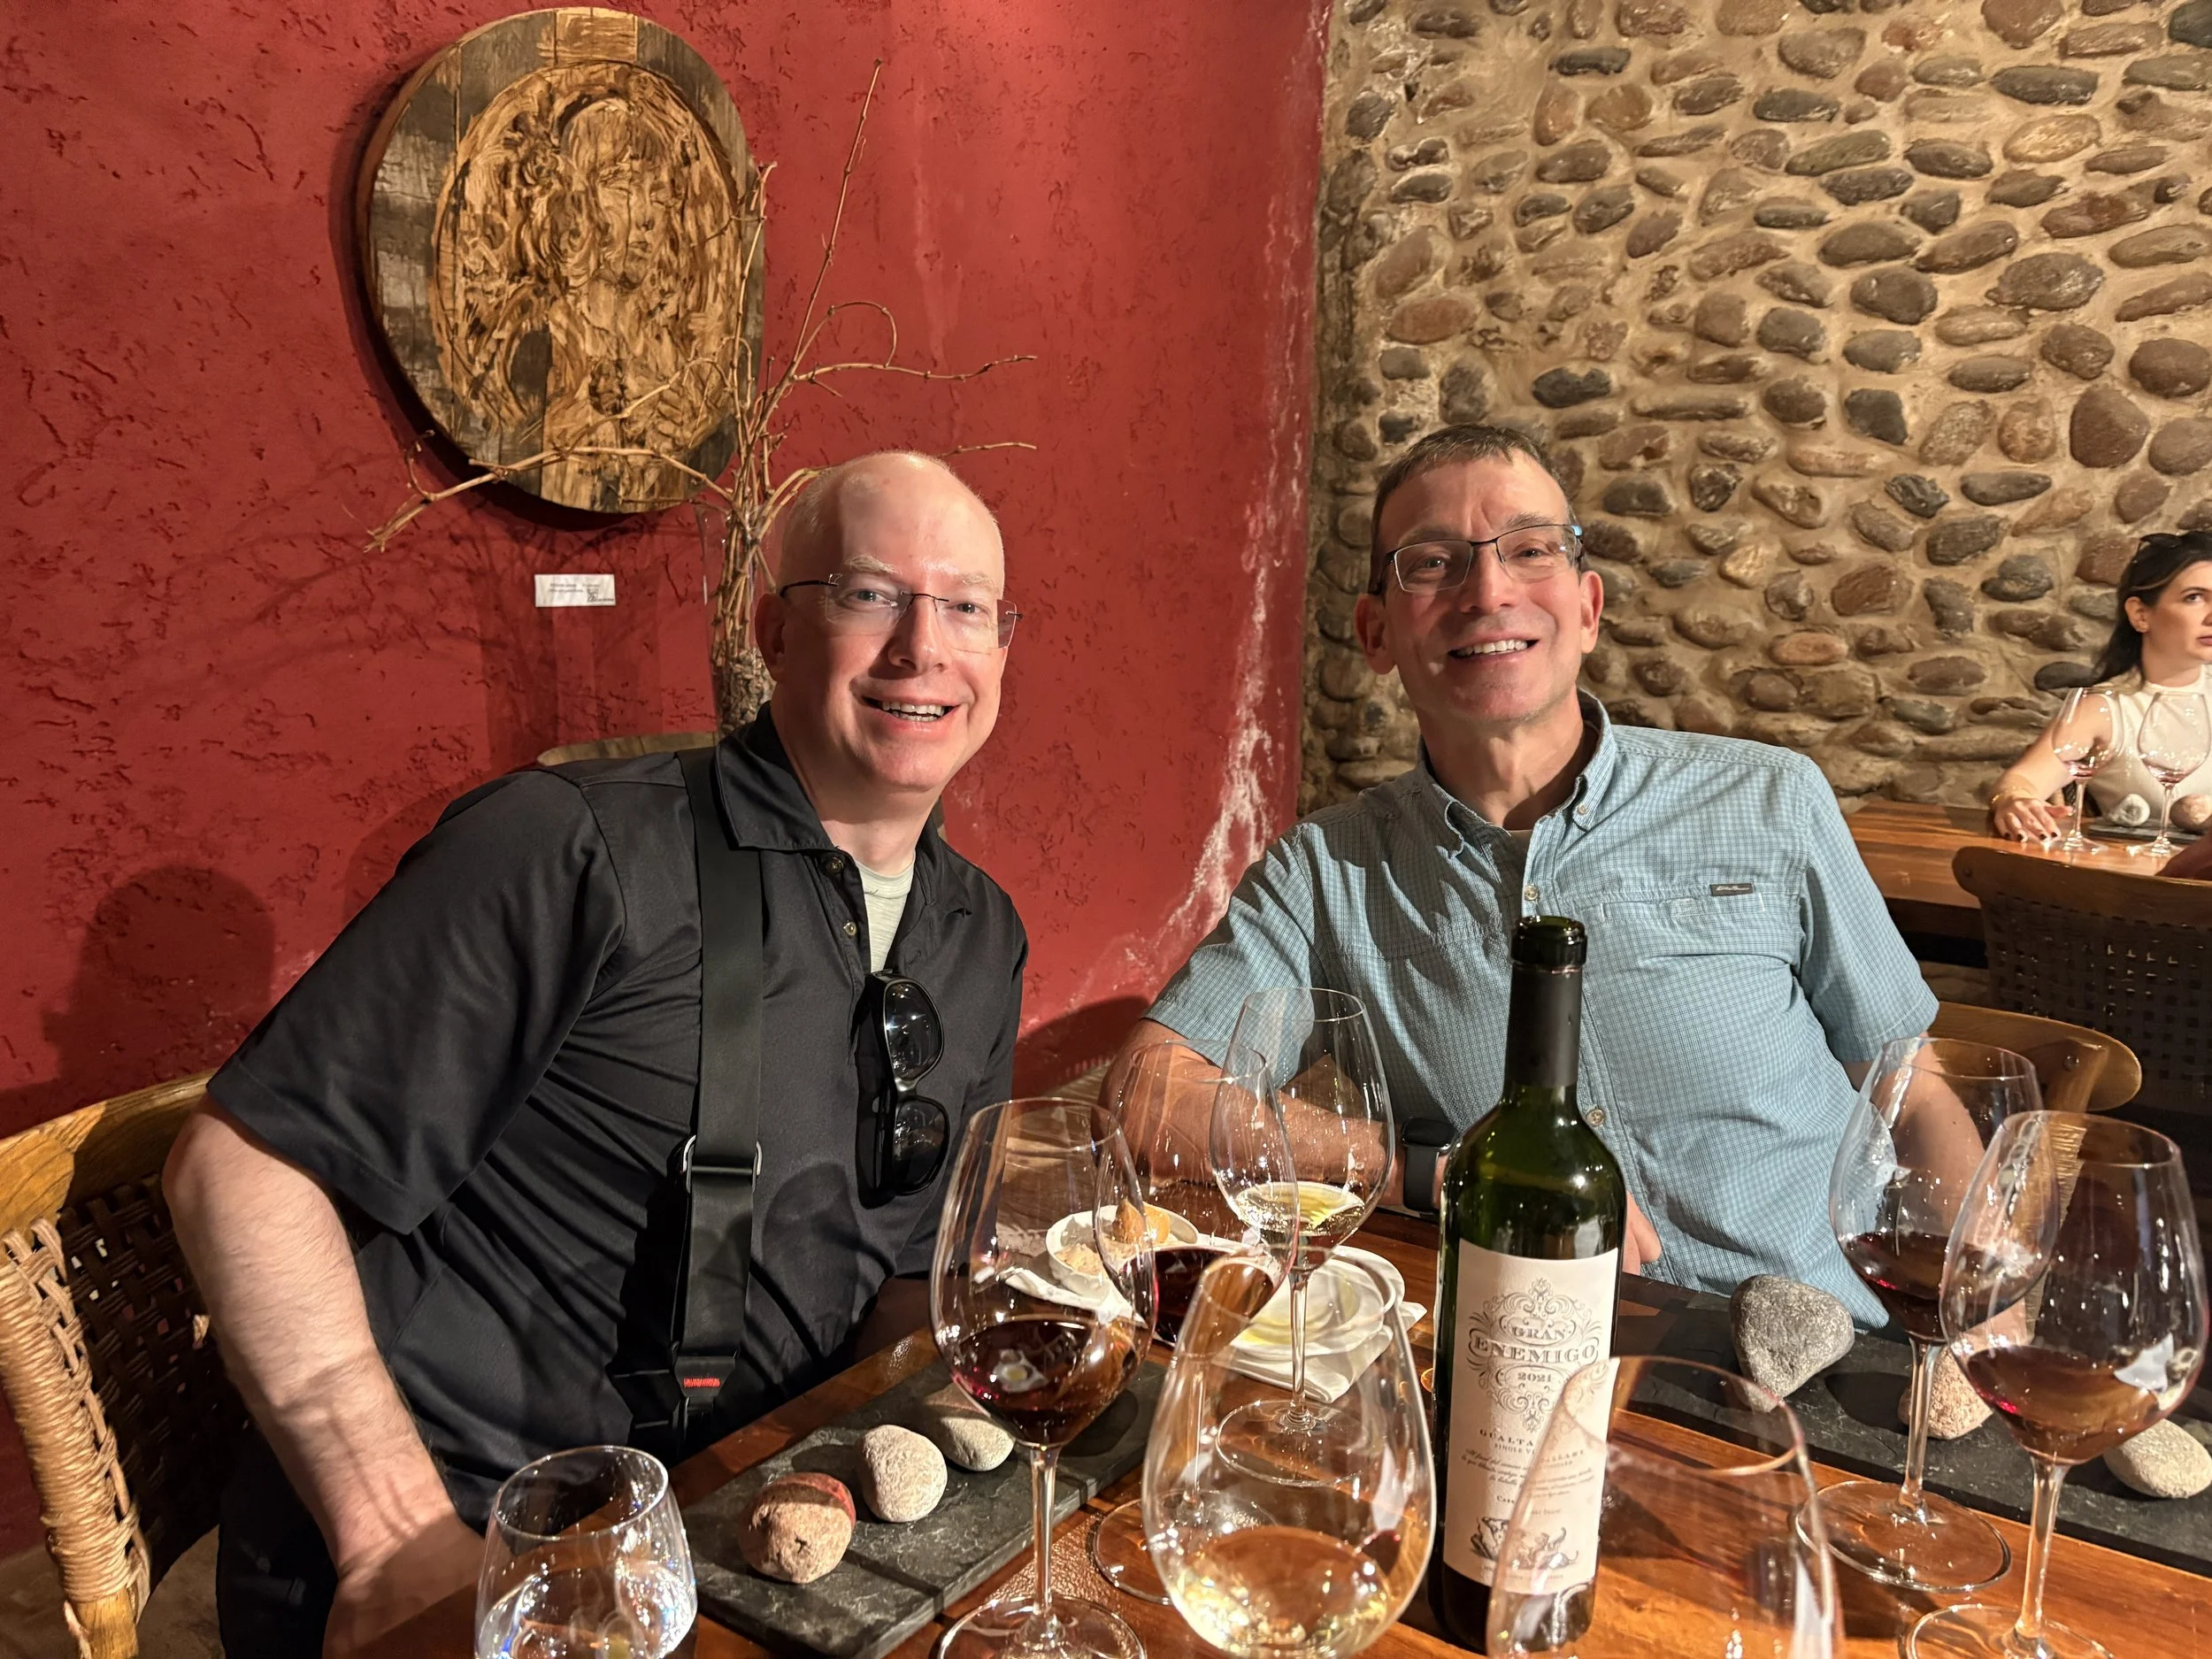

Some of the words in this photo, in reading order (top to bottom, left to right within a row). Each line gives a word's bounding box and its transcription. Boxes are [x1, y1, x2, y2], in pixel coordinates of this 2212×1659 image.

[1511, 1325, 1565, 1340] GRAN
[1474, 1336, 1595, 1363] ENEMIGO
[1517, 1371, 1552, 1382] 2021
